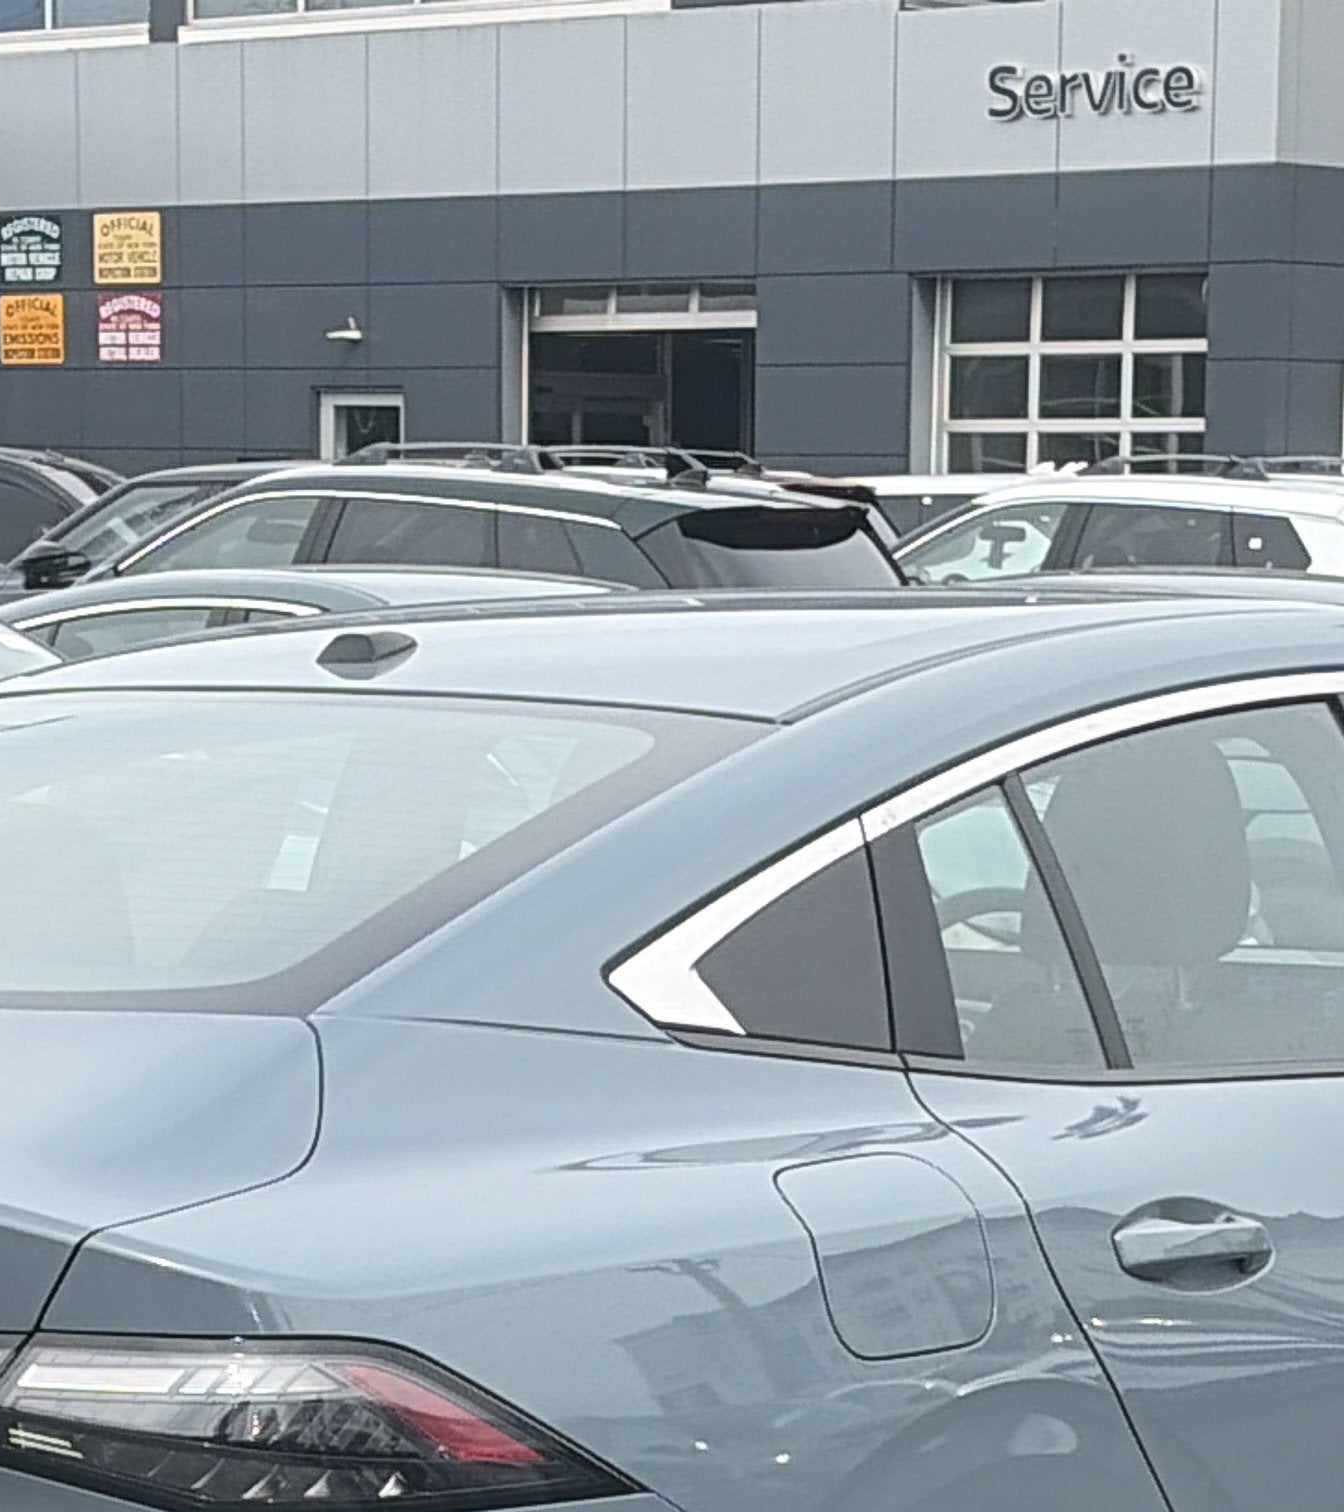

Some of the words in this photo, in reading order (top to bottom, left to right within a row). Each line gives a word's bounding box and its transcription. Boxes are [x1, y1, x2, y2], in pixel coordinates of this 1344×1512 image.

[987, 53, 1196, 118] Service
[100, 216, 154, 238] OFFICIAL
[5, 297, 58, 318] OFFICIAL
[3, 332, 59, 346] EMISSIONS
